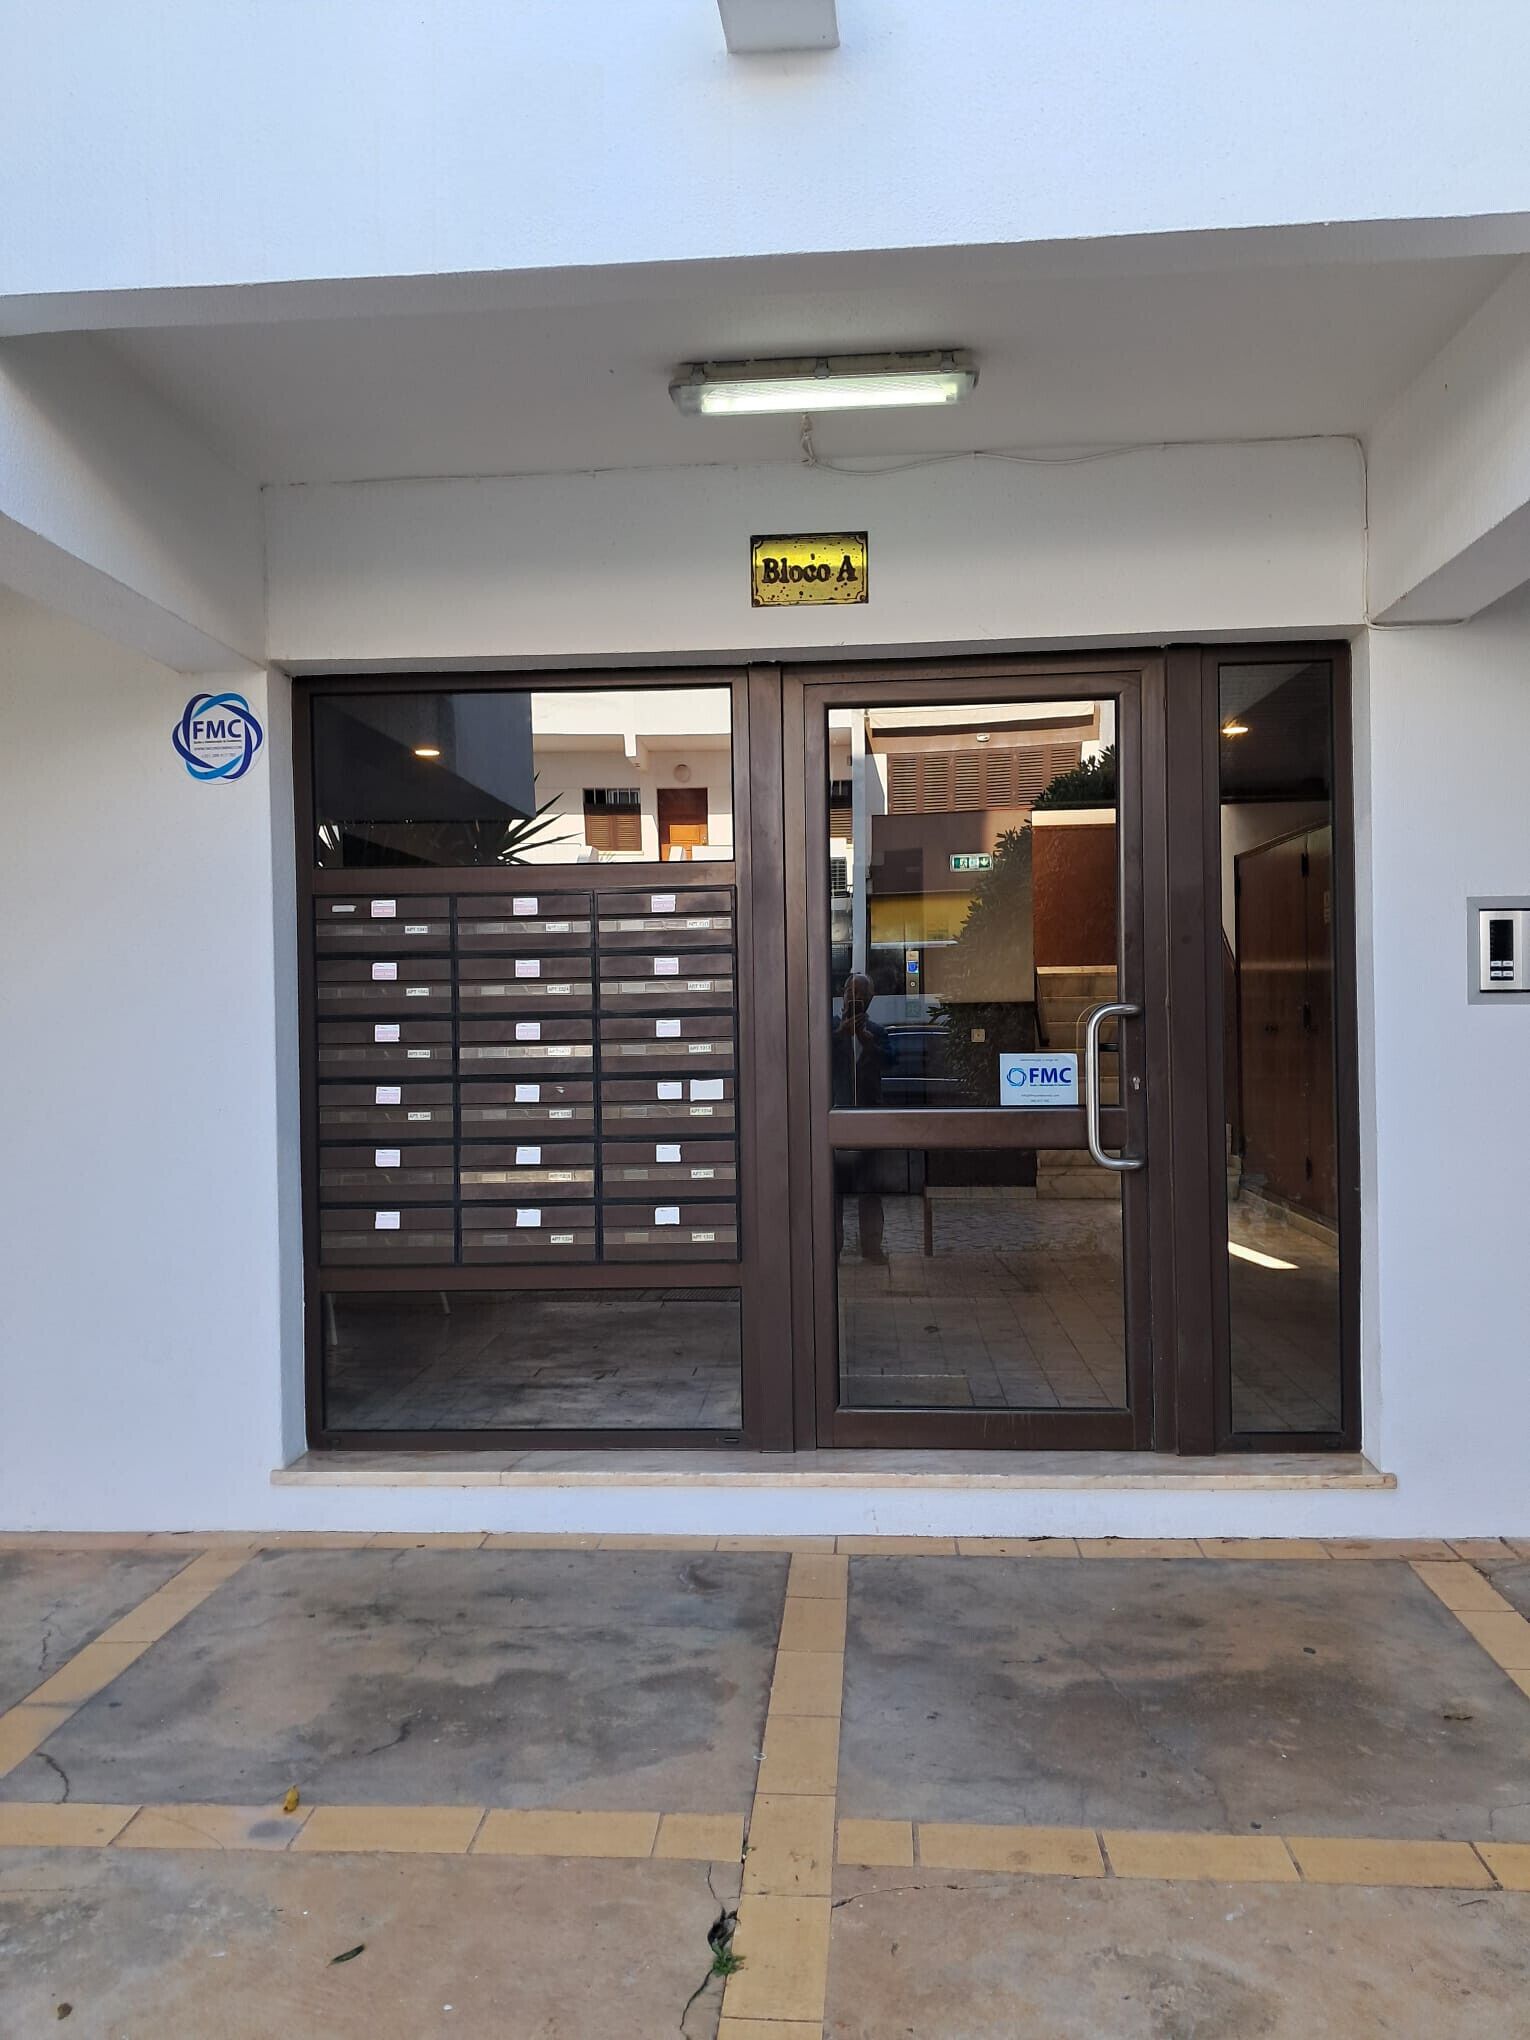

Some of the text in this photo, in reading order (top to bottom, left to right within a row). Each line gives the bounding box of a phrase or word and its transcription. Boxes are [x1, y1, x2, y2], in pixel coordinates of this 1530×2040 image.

[762, 555, 858, 583] Bloco A
[193, 719, 242, 739] FMC
[1029, 1067, 1072, 1084] FMC
